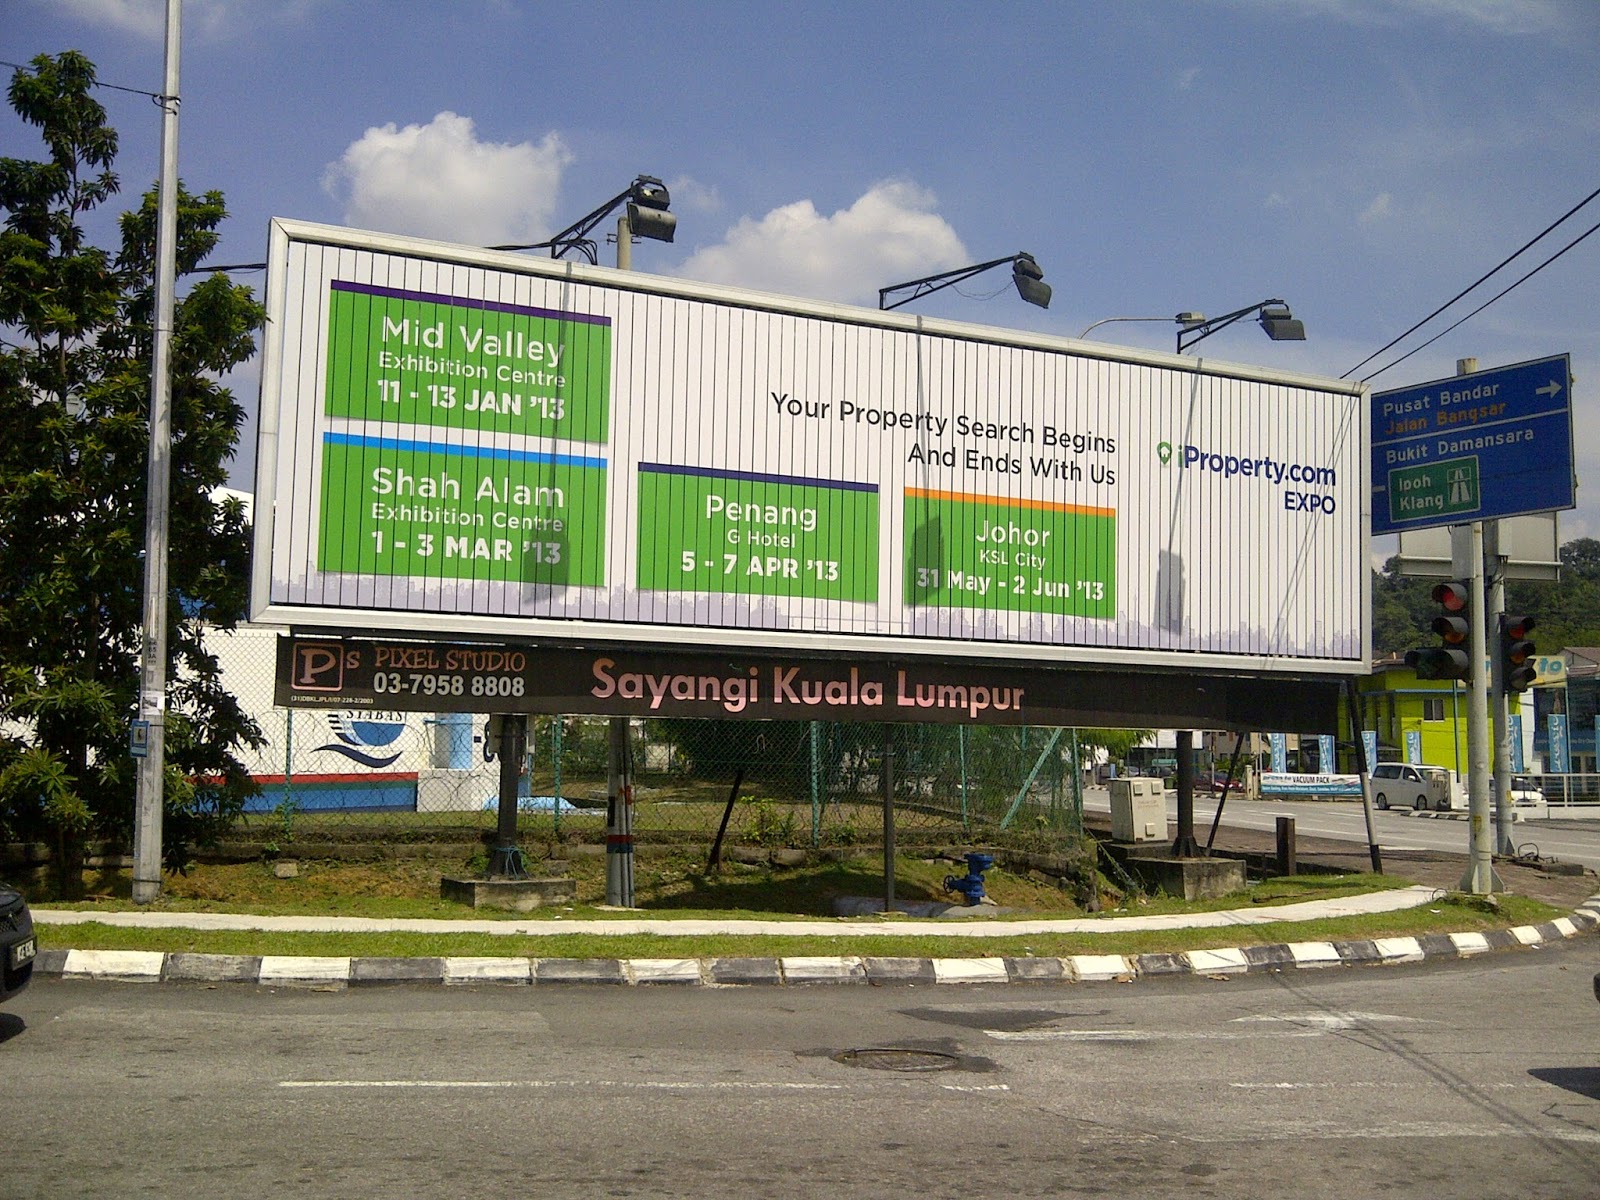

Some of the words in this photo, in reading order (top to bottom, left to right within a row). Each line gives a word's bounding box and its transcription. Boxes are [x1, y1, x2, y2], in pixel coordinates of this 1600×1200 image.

[382, 316, 444, 349] Mid
[459, 325, 565, 368] Valley
[379, 351, 488, 380] Exhibition
[496, 365, 566, 388] Centre
[377, 379, 400, 403] 11
[427, 384, 457, 409] 13
[464, 390, 521, 416] JAN
[1384, 395, 1431, 417] Pusat
[1440, 383, 1499, 406] Bandar
[771, 392, 830, 421] Your
[839, 400, 948, 437] Property
[957, 415, 1034, 444] Search
[1043, 426, 1116, 455] Begins
[1385, 417, 1427, 435] Jalan
[1437, 403, 1506, 426] Bangsar
[1386, 444, 1427, 464] Bukit
[1438, 428, 1534, 455] Damansara
[908, 443, 956, 469] And
[966, 450, 1022, 475] Ends
[1030, 457, 1083, 482] With
[1090, 464, 1116, 486] Us
[1177, 444, 1337, 487] iProperty.com
[372, 467, 460, 500] Shah
[474, 476, 564, 508] Alam
[1399, 474, 1431, 492] Ipoh
[372, 503, 484, 527] Exhibition
[492, 511, 563, 532] Centre
[705, 495, 817, 532] Penang
[1284, 491, 1337, 515] EXPO
[1400, 494, 1444, 510] Klang
[372, 530, 383, 554] 1
[417, 534, 433, 557] 3
[445, 537, 512, 562] MAR
[727, 530, 740, 544] G
[747, 531, 796, 548] Hotel
[976, 520, 1051, 548] Johor
[681, 551, 695, 573] 5
[723, 554, 737, 575] 7
[746, 555, 799, 579] APR
[979, 549, 1008, 565] KSL
[1015, 552, 1046, 570] City
[916, 567, 940, 588] 31
[947, 570, 990, 596] May
[1013, 575, 1025, 595] 2
[1033, 576, 1070, 599] Jun
[375, 647, 439, 669] PIXEL
[446, 649, 526, 672] STUDIO
[373, 672, 464, 696] 03-7958
[471, 675, 525, 697] 8808
[591, 658, 758, 713] Sayangi
[774, 666, 883, 706] Kuala
[896, 670, 1025, 718] Lumpur
[1316, 776, 1330, 784] PACK
